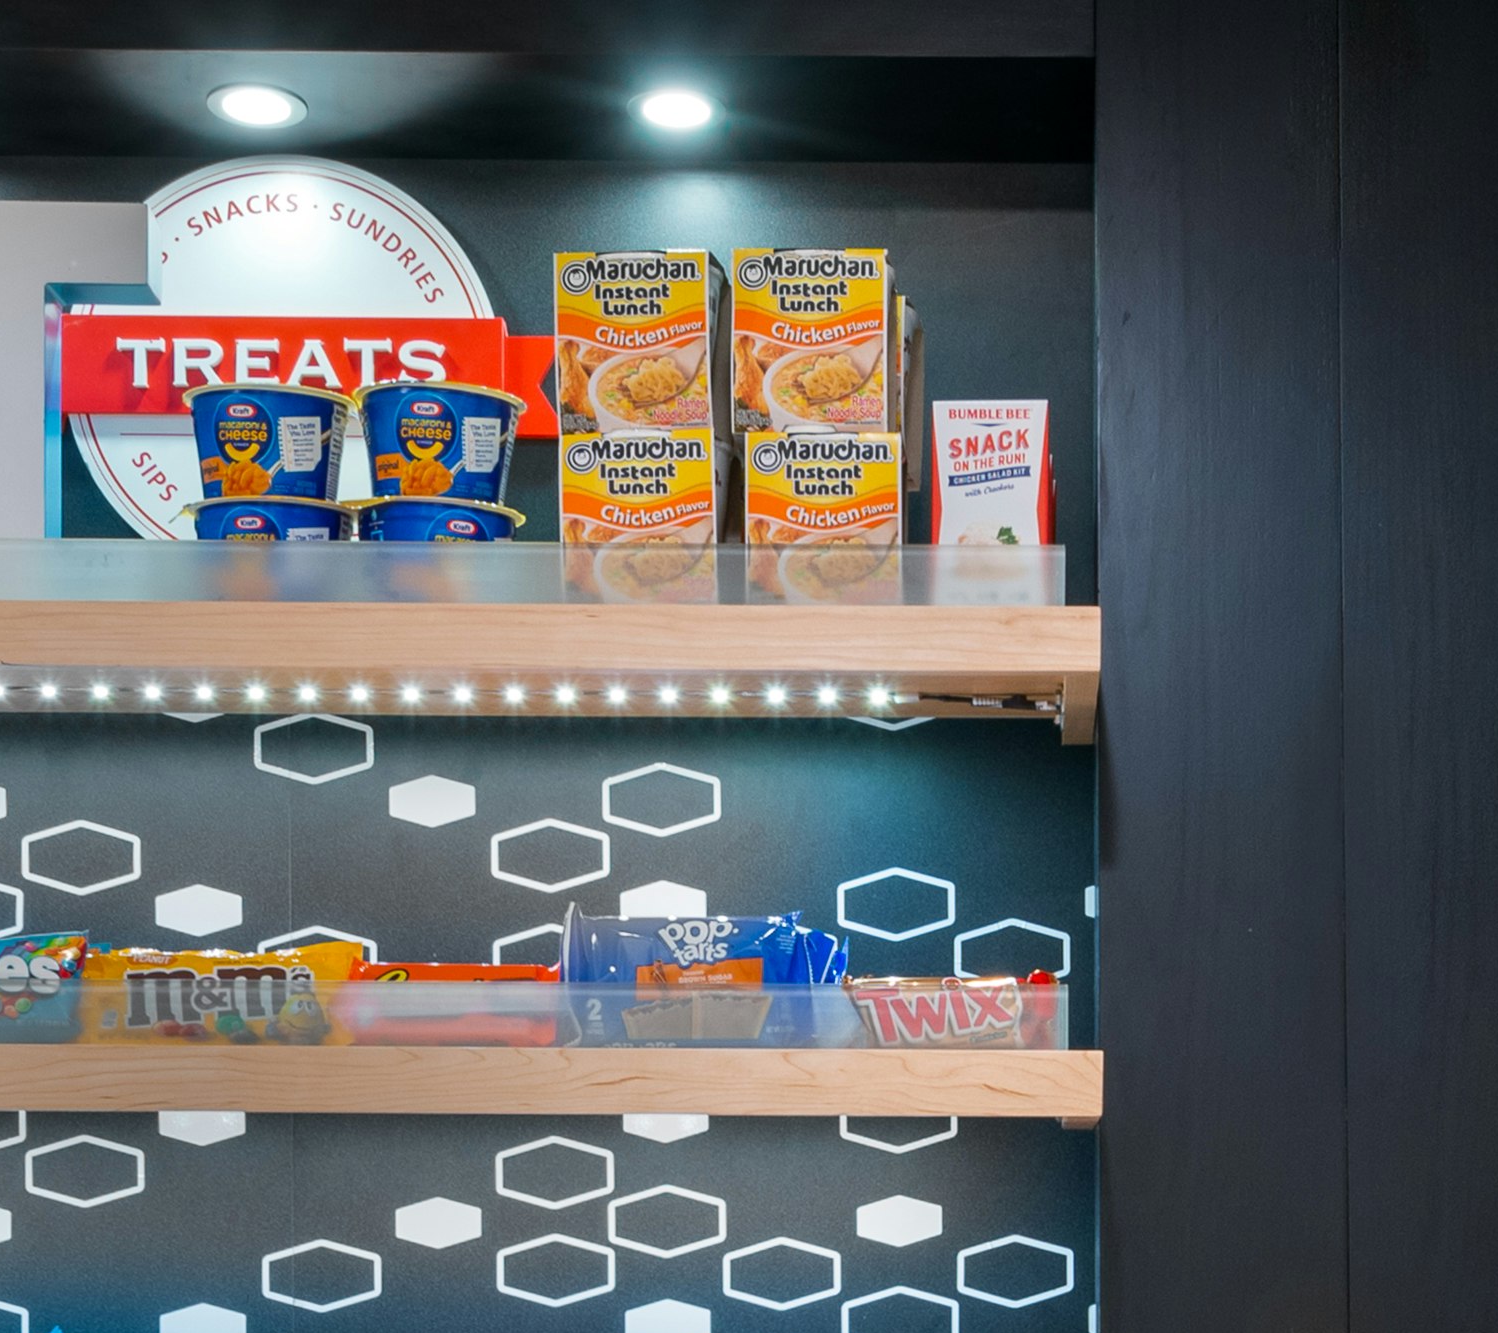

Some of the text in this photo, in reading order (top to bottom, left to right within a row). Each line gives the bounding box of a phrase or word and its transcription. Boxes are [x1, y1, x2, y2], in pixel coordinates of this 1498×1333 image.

[187, 194, 445, 303] SNACKS SUNDRIES
[584, 258, 697, 282] Maruchan
[762, 255, 875, 279] Maruchan
[594, 284, 670, 300] Instant
[771, 281, 847, 297] Instant
[603, 299, 662, 315] Lunch
[780, 296, 840, 313] Lunch
[595, 320, 702, 347] Chicken Flavor
[771, 318, 880, 344] Chicken Flavor
[116, 338, 447, 389] TREATS
[232, 407, 251, 415] Kraft
[677, 398, 707, 408] Ramen
[653, 408, 708, 420] Noodle Soup
[949, 409, 1030, 419] BUMBLE BEE
[591, 439, 702, 461] Maruchan
[777, 440, 888, 462] Maruchan
[949, 429, 1029, 459] SNACK
[600, 463, 675, 479] Instant
[954, 453, 1025, 472] ON THE RUN!
[132, 451, 178, 502] SIPS
[785, 464, 861, 480] Instant
[954, 467, 1025, 484] CHICKEN SALAD KIT
[608, 479, 668, 496] Lunch
[794, 480, 854, 497] Lunch
[601, 503, 675, 525] Chicken
[785, 505, 860, 527] Chicken
[133, 954, 171, 964] PEANUT
